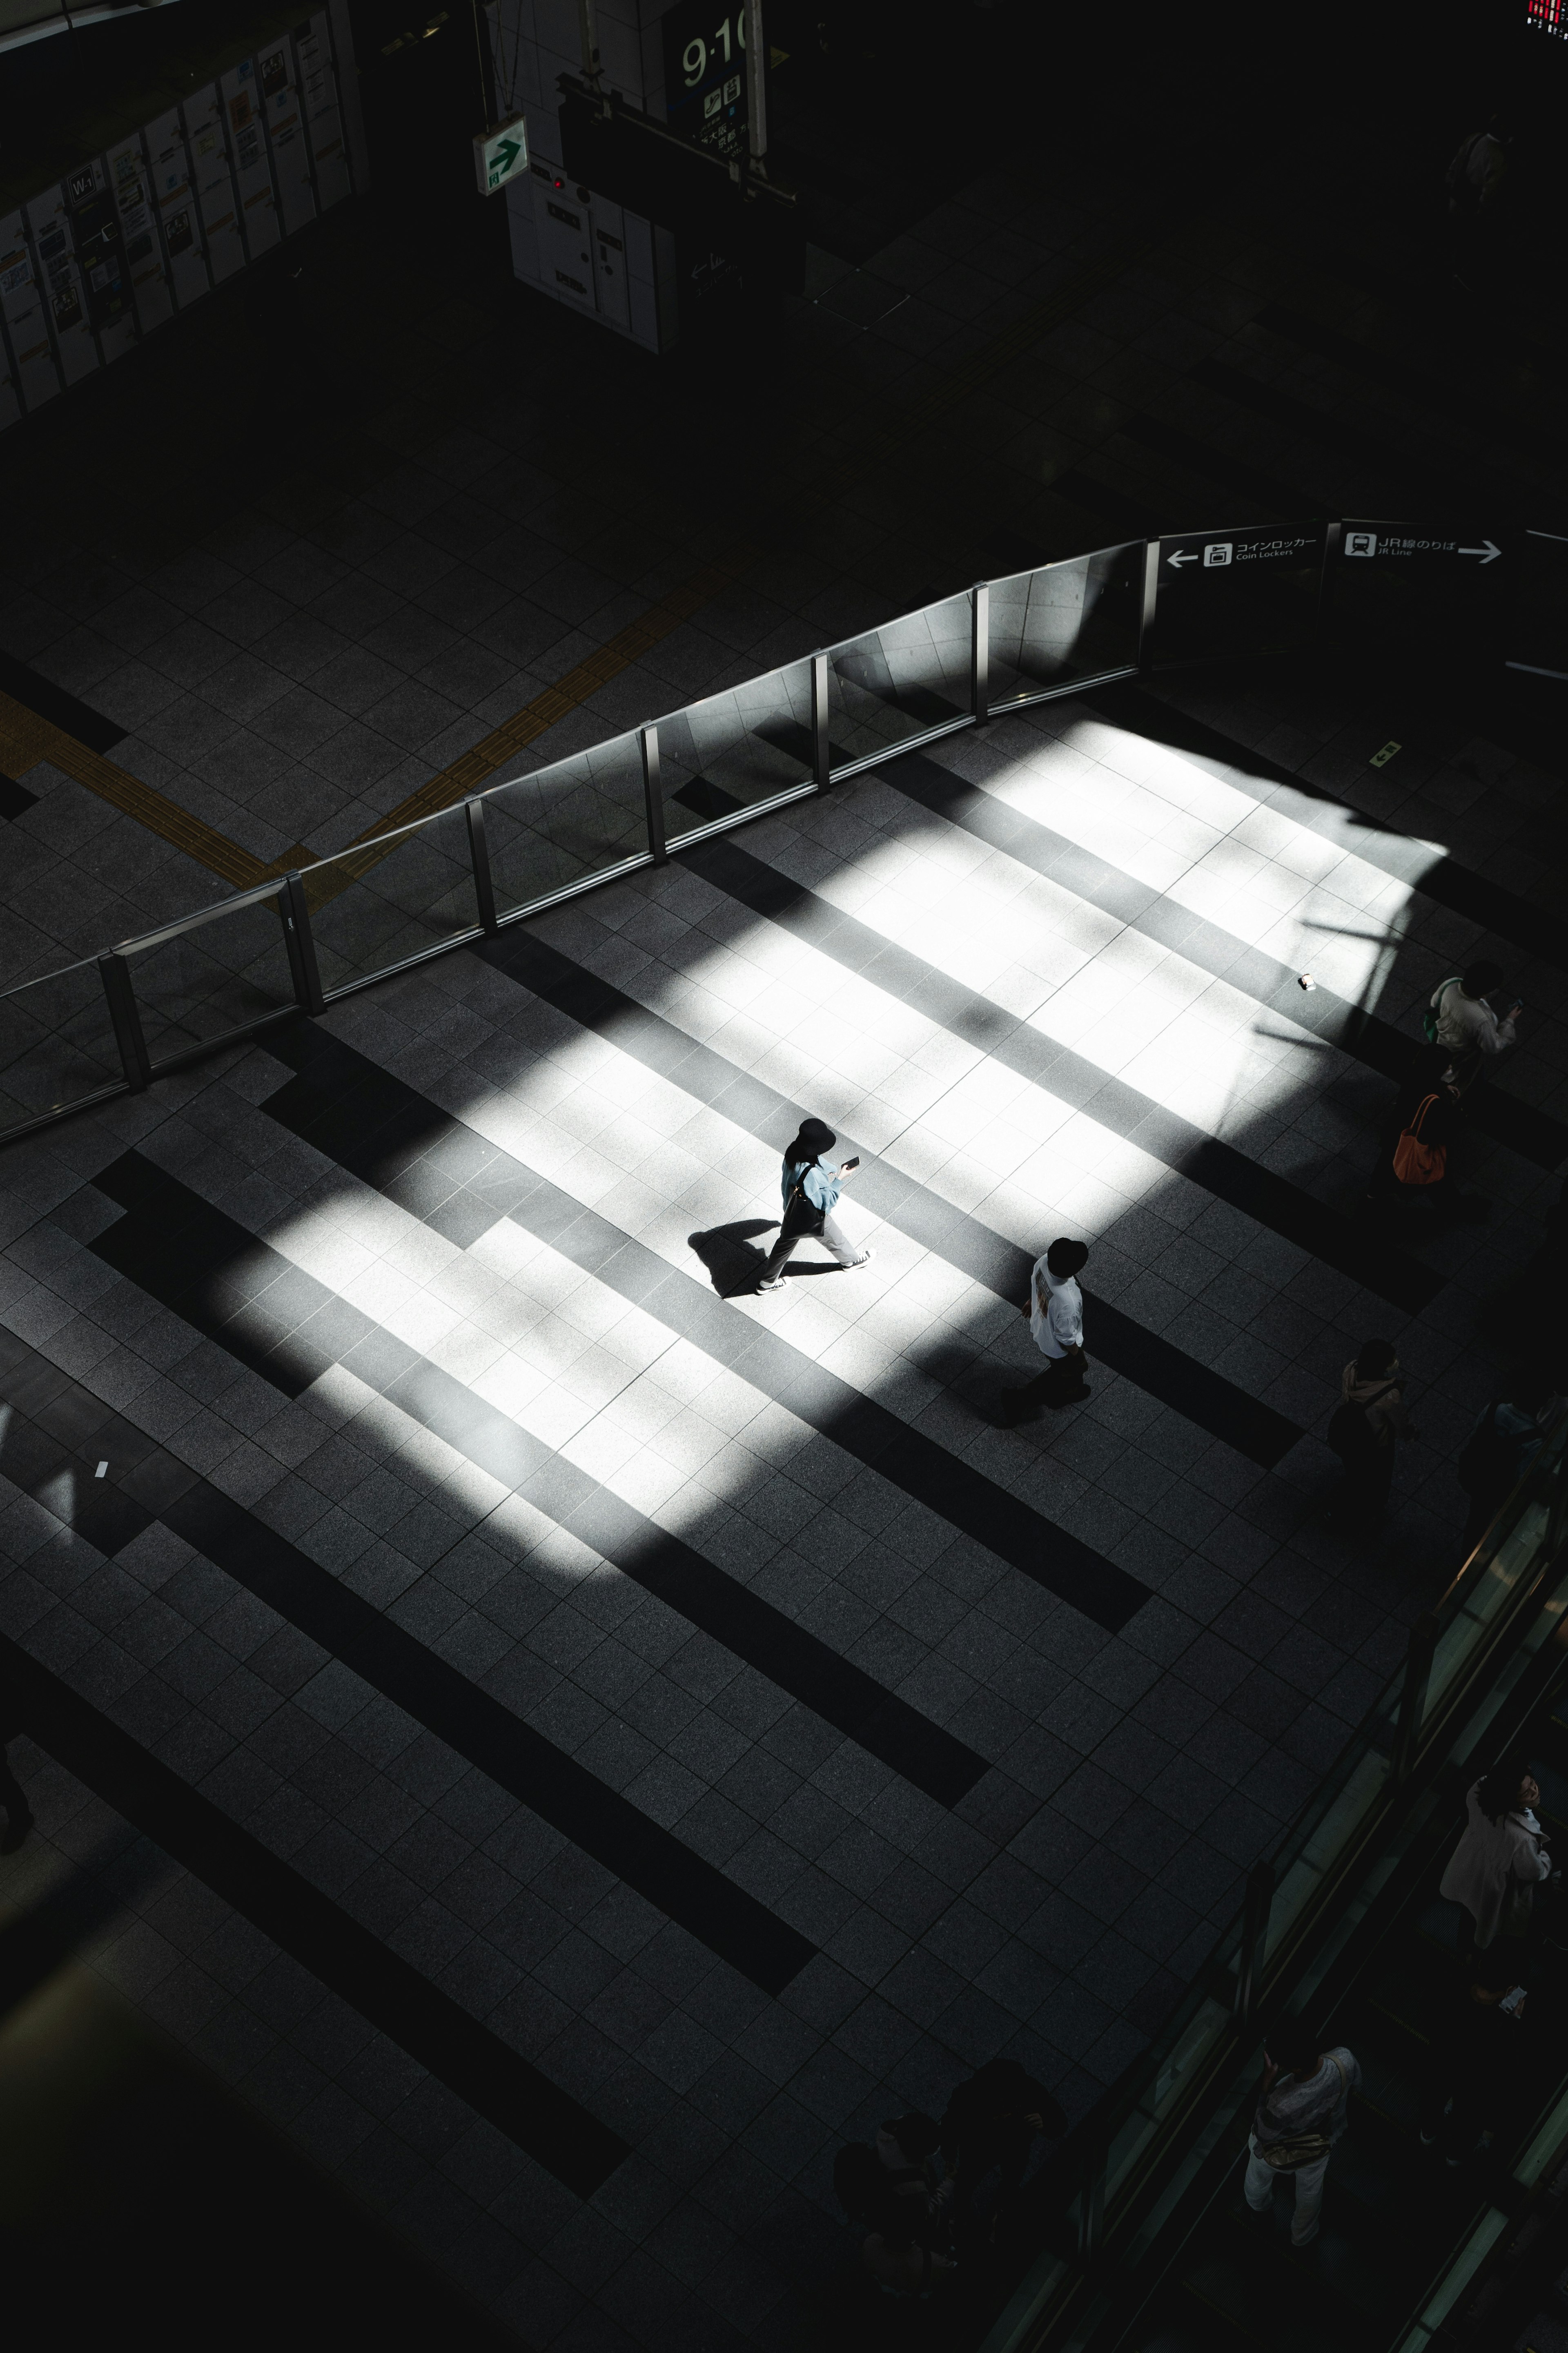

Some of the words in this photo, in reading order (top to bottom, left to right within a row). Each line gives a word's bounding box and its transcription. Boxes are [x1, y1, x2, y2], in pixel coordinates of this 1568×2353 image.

[73, 177, 92, 196] W-1
[1237, 538, 1317, 553] コインロッカー
[1378, 538, 1457, 551] JR線のりば
[1236, 553, 1257, 561] Coin
[1259, 550, 1293, 559] Lockers
